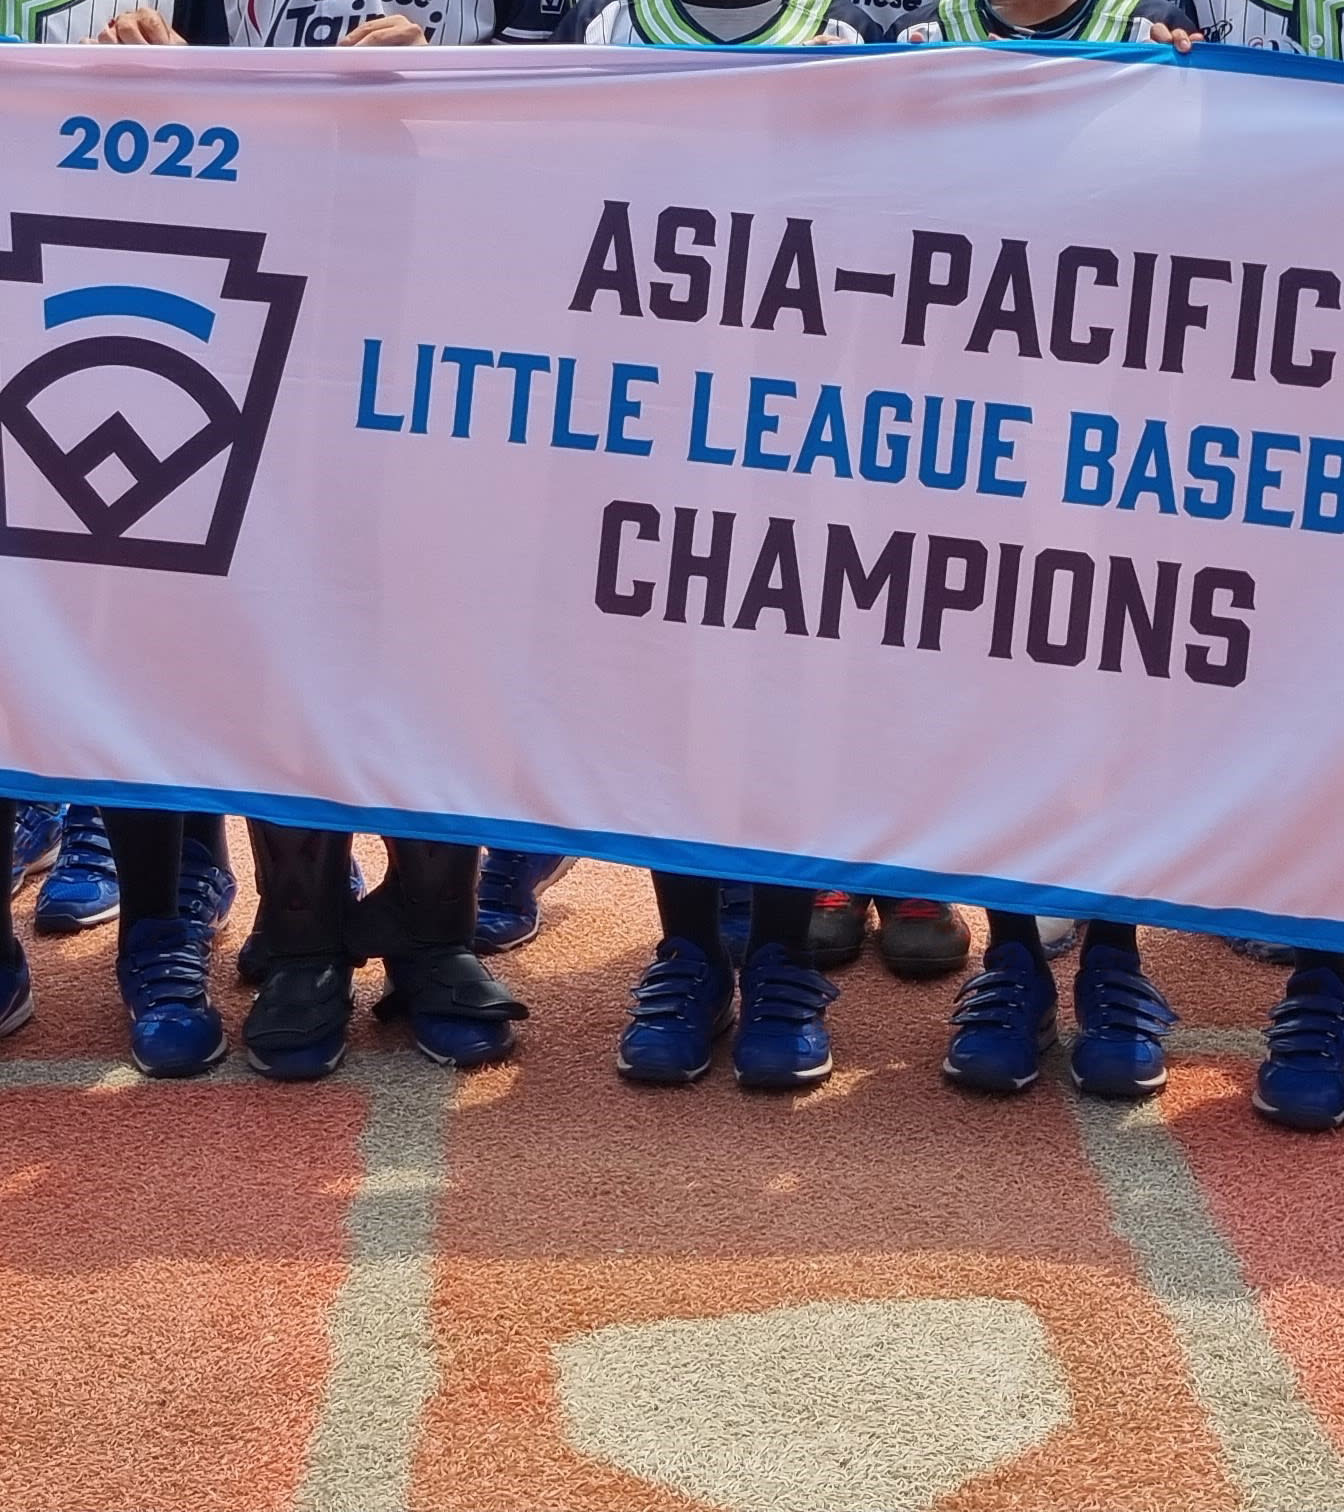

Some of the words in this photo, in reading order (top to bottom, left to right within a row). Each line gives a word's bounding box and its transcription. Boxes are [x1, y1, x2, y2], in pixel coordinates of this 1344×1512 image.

[57, 116, 240, 181] 2022
[568, 200, 1341, 388] ASIA-PACIFIC
[356, 339, 659, 456] LITTLE
[687, 372, 1032, 497] LEAGUE
[595, 500, 1255, 687] CHAMPIONS
